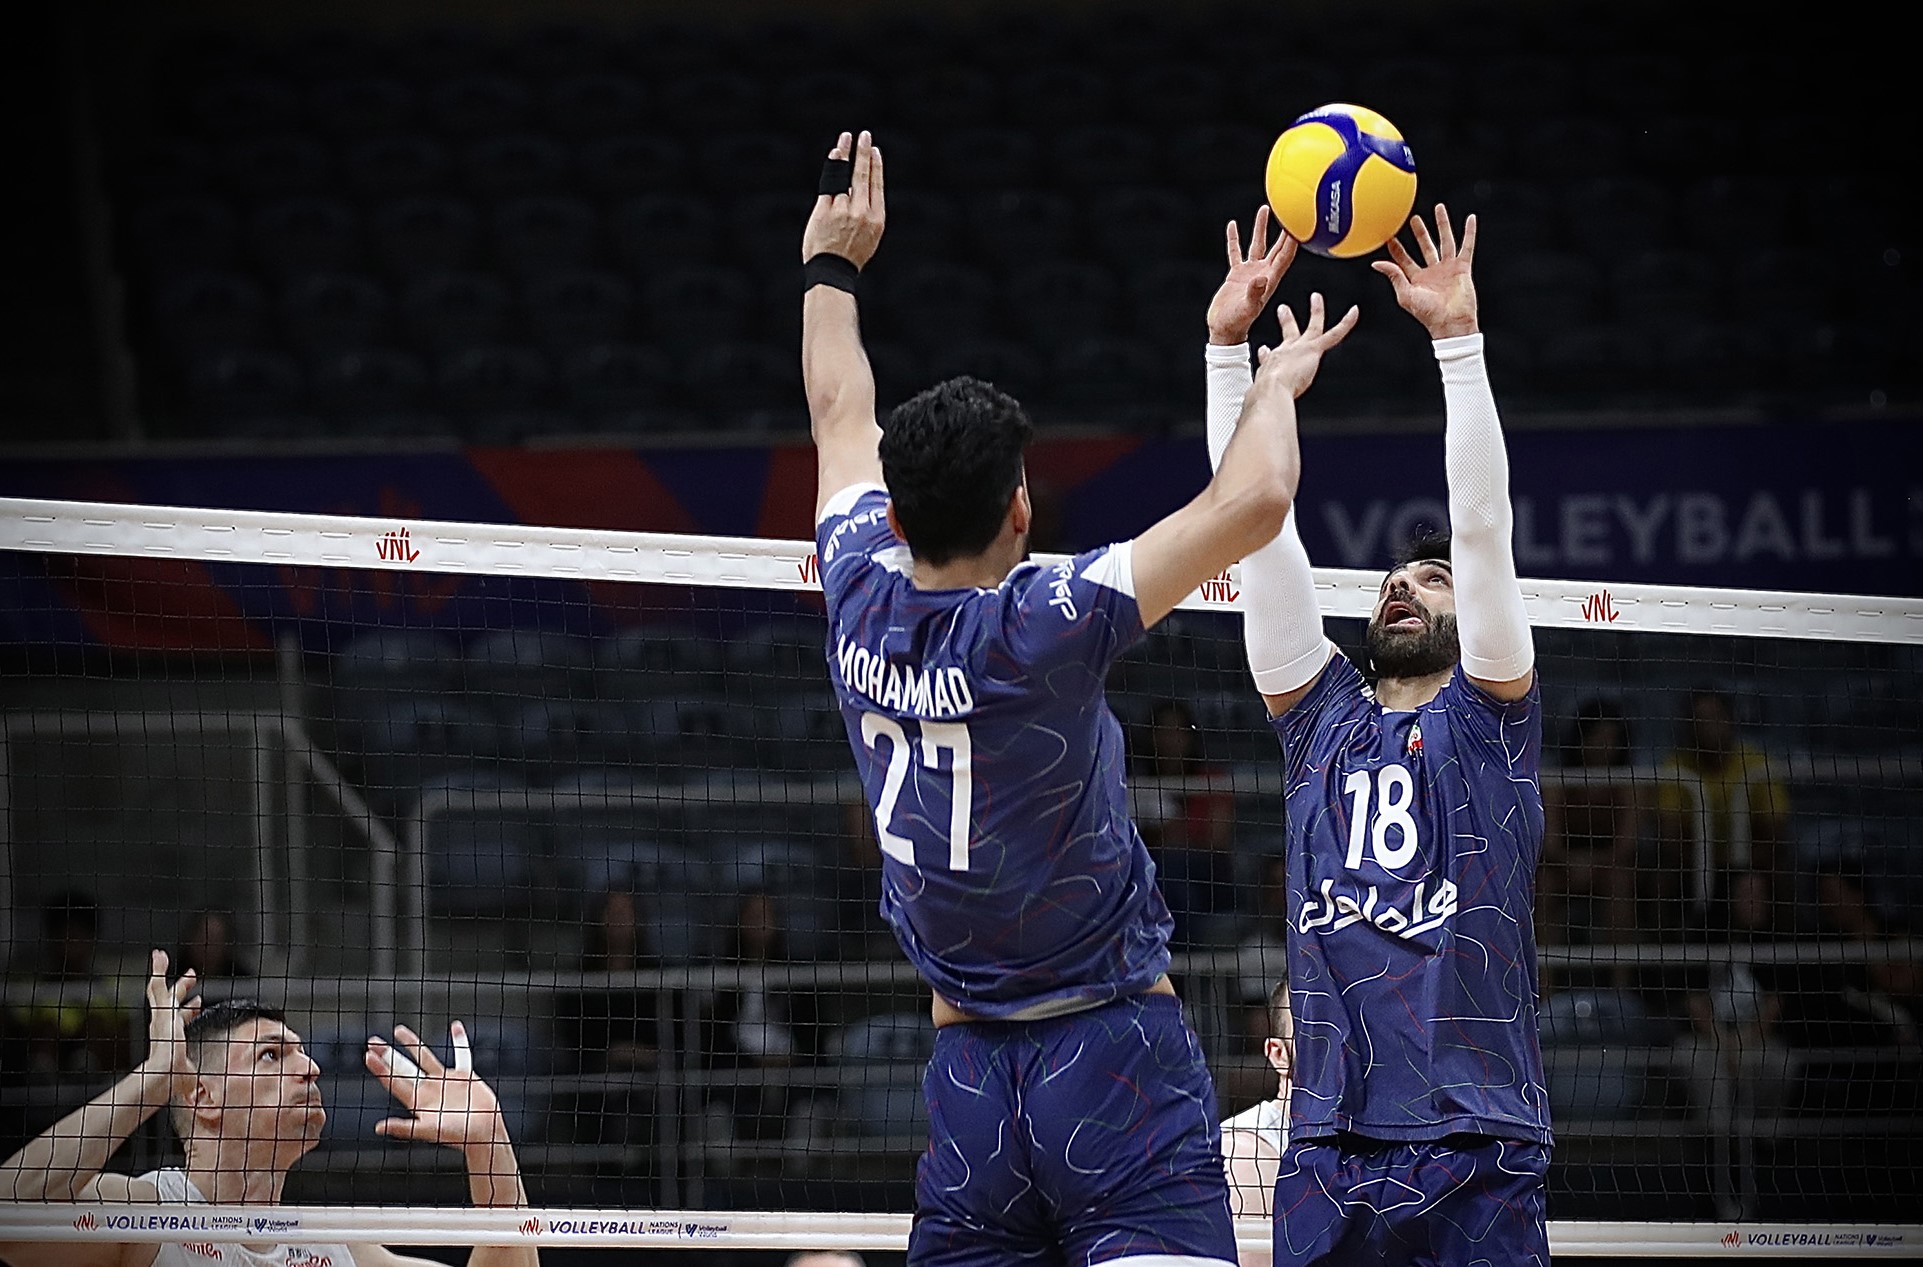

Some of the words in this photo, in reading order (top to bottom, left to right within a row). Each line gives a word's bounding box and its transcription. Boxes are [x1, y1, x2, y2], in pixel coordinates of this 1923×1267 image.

[1319, 487, 1895, 567] VOLEYBALL
[376, 527, 420, 563] VNL
[1582, 590, 1619, 623] VNL
[861, 711, 972, 872] 27
[1344, 764, 1418, 870] 18
[105, 1215, 209, 1231] VOLLEYBALL
[212, 1216, 243, 1224] NATIONS
[549, 1221, 646, 1235] VOLLEYBALL
[650, 1221, 679, 1229] NATIONS
[1748, 1233, 1832, 1246] VOLLEYBALL
